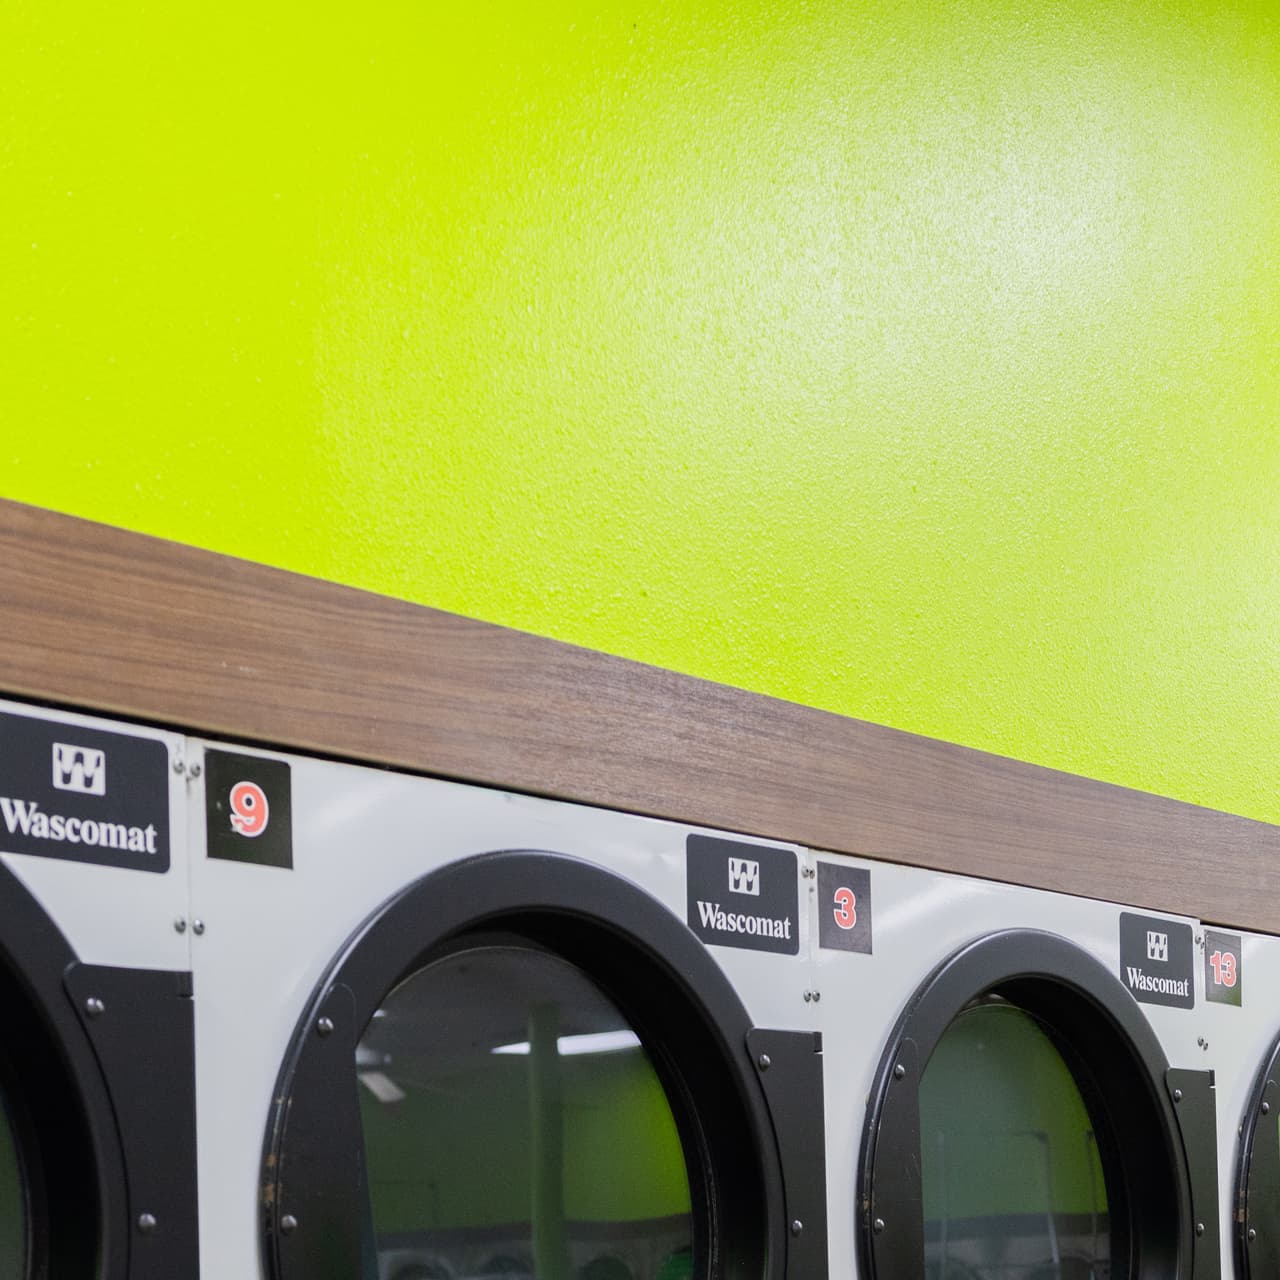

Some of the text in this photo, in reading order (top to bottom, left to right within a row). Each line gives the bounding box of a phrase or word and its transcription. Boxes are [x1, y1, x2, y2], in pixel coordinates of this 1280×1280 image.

[228, 780, 270, 838] 9
[696, 900, 791, 940] Wascomat
[833, 887, 857, 929] 3
[1126, 966, 1189, 997] Wascomat
[1209, 950, 1237, 987] 13
